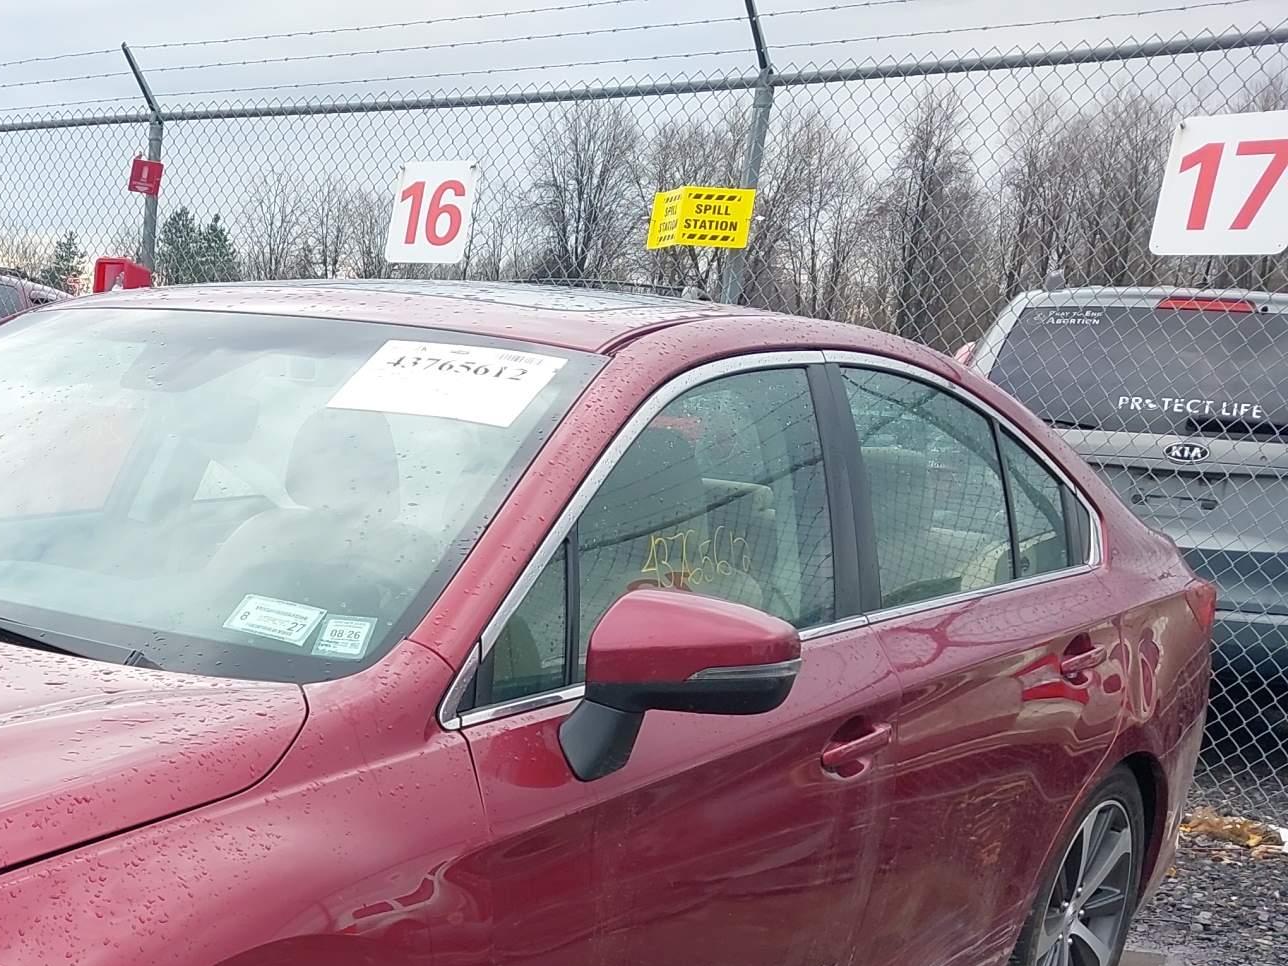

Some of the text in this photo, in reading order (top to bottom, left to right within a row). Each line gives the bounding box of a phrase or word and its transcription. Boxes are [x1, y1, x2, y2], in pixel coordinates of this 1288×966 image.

[1179, 138, 1288, 231] 17
[400, 179, 466, 246] 16
[695, 203, 731, 216] SPILL
[683, 218, 738, 231] STATION
[386, 355, 528, 381] 43765612
[1221, 402, 1262, 418] LIFE
[1171, 446, 1202, 458] KIA
